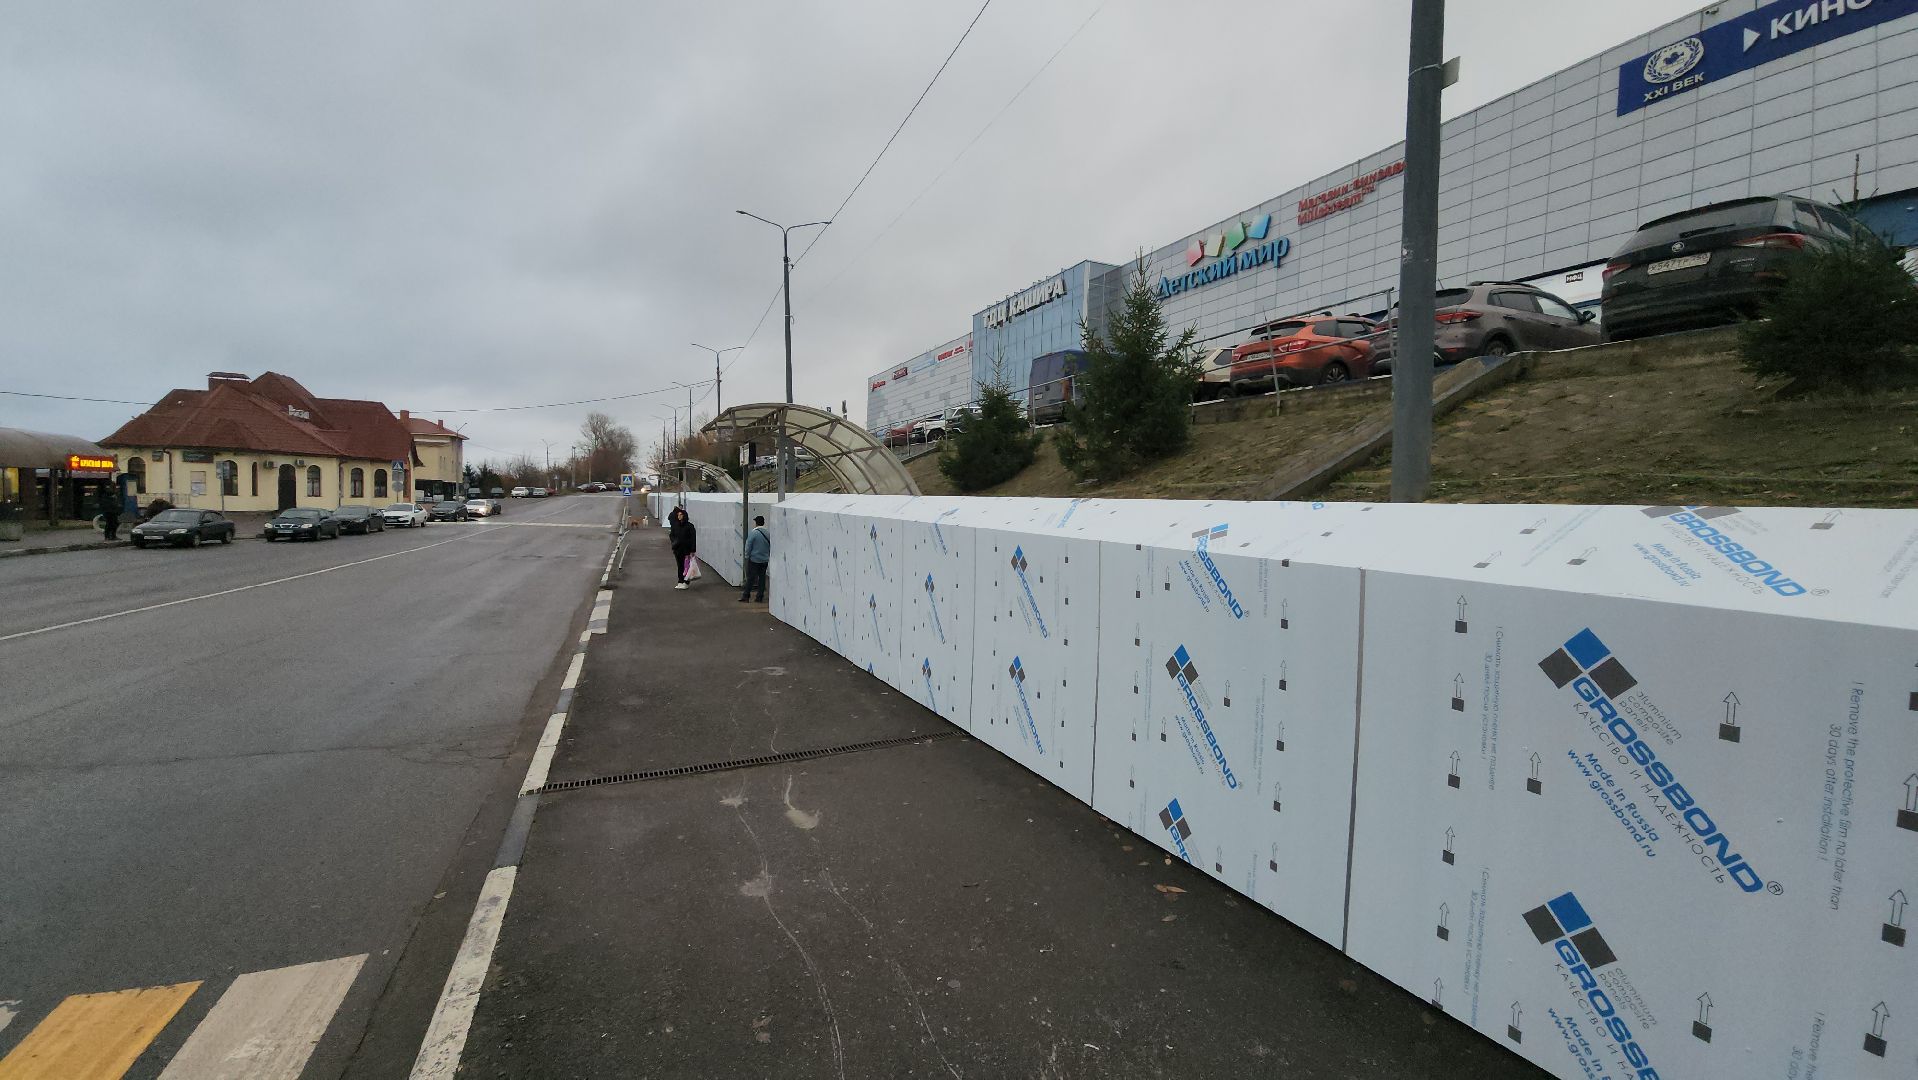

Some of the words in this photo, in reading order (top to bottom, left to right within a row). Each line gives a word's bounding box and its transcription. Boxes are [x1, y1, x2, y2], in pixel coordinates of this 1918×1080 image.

[1672, 72, 1705, 91] ВЕК
[1157, 252, 1238, 301] Детский
[1240, 236, 1290, 269] мир
[1669, 512, 1807, 597] GROSSBOND
[1176, 672, 1238, 790] GROSSBOND
[1619, 701, 1651, 734] panels
[1627, 695, 1675, 746] composite
[1829, 723, 1842, 738] 30
[1848, 688, 1864, 735] Remove
[1825, 739, 1838, 765] days
[1847, 737, 1859, 756] the
[1567, 749, 1656, 858] www.grossbond.ru
[1572, 676, 1764, 893] GROSSBOND
[1573, 702, 1629, 765] КАЧЕСТВО
[1630, 769, 1642, 780] И
[1641, 783, 1726, 884] НАДЕЖНОСТЬ
[1584, 752, 1615, 788] Made
[1613, 788, 1626, 802] in
[1624, 802, 1660, 842] Russia
[1825, 768, 1836, 796] after
[1840, 758, 1856, 817] protective
[1819, 797, 1835, 855] installation
[1835, 840, 1846, 855] no
[1832, 856, 1847, 882] later
[1554, 963, 1607, 1038] КАЧЕСТВО
[1564, 1016, 1593, 1057] Made
[1591, 1058, 1603, 1072] in
